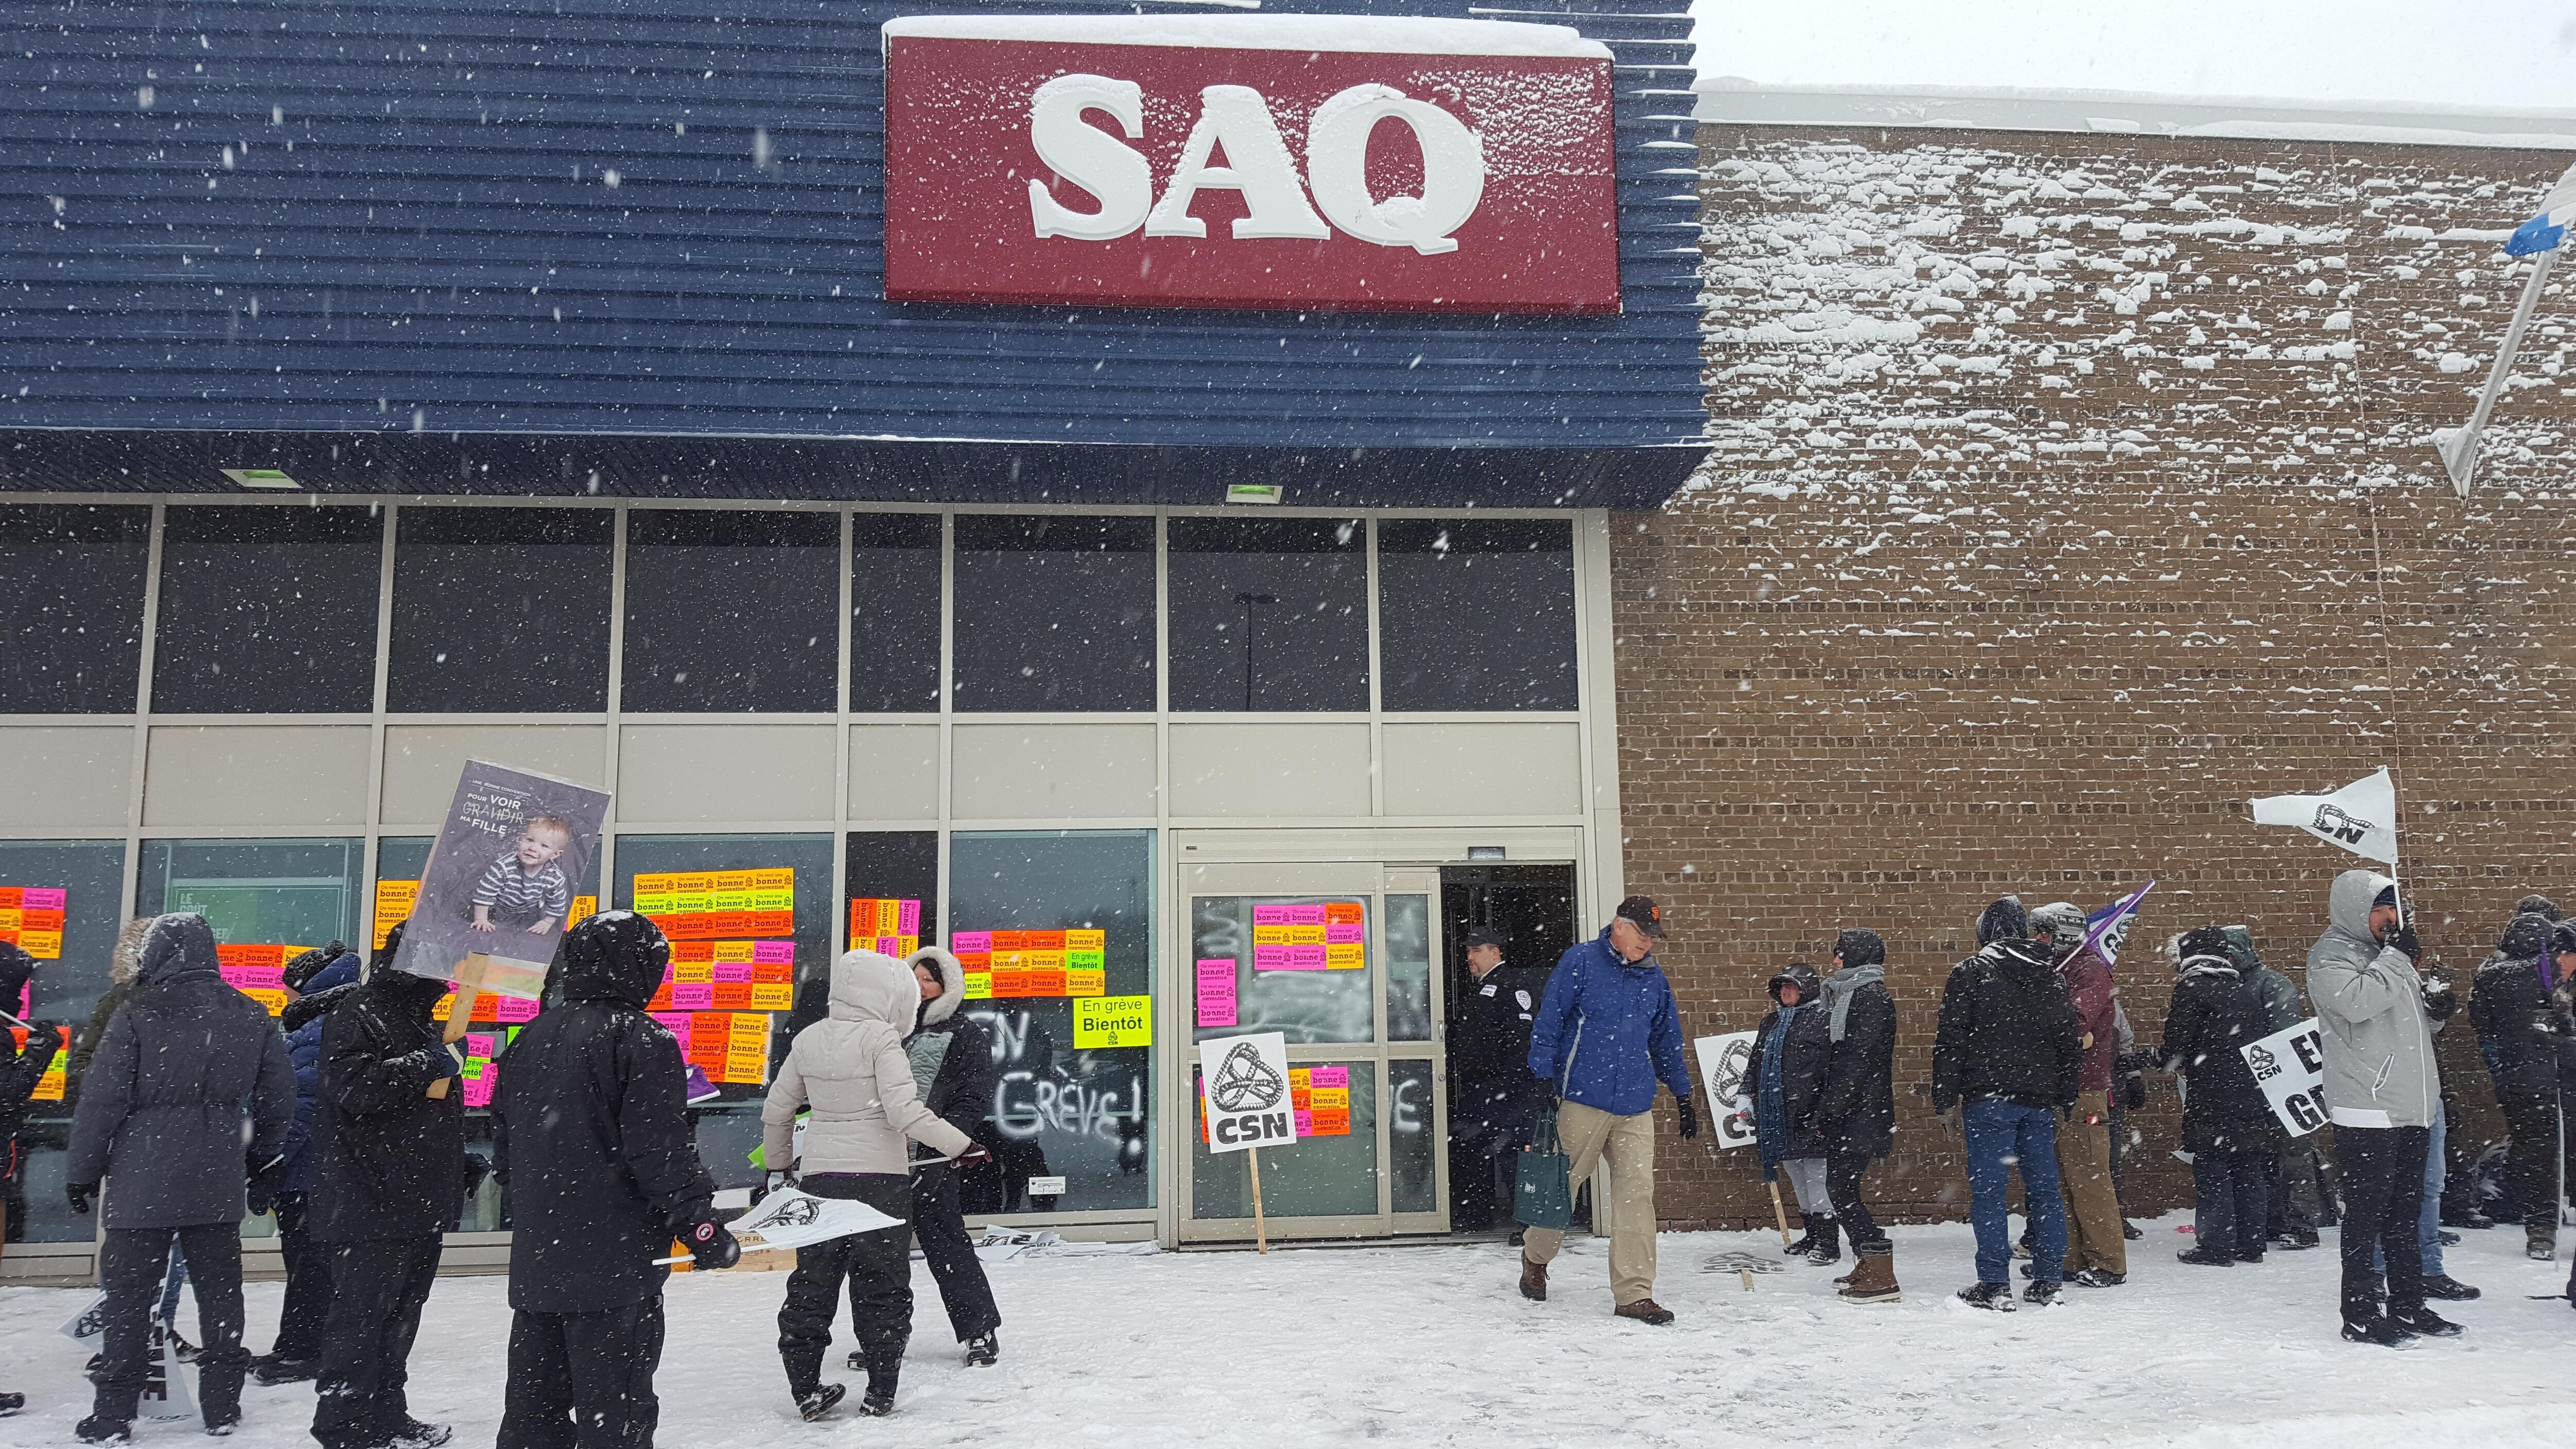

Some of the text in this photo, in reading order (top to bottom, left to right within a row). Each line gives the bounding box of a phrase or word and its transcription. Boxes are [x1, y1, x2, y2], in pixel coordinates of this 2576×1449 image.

[1029, 74, 1484, 256] SAQ
[501, 787, 531, 797] CONVENTION
[467, 793, 521, 810] POUR VOIR
[472, 819, 507, 834] FILLE
[1083, 999, 1142, 1014] En grève
[1084, 1016, 1142, 1031] Bientôt
[2257, 1065, 2282, 1081] CSN
[1216, 1112, 1288, 1144] CSN
